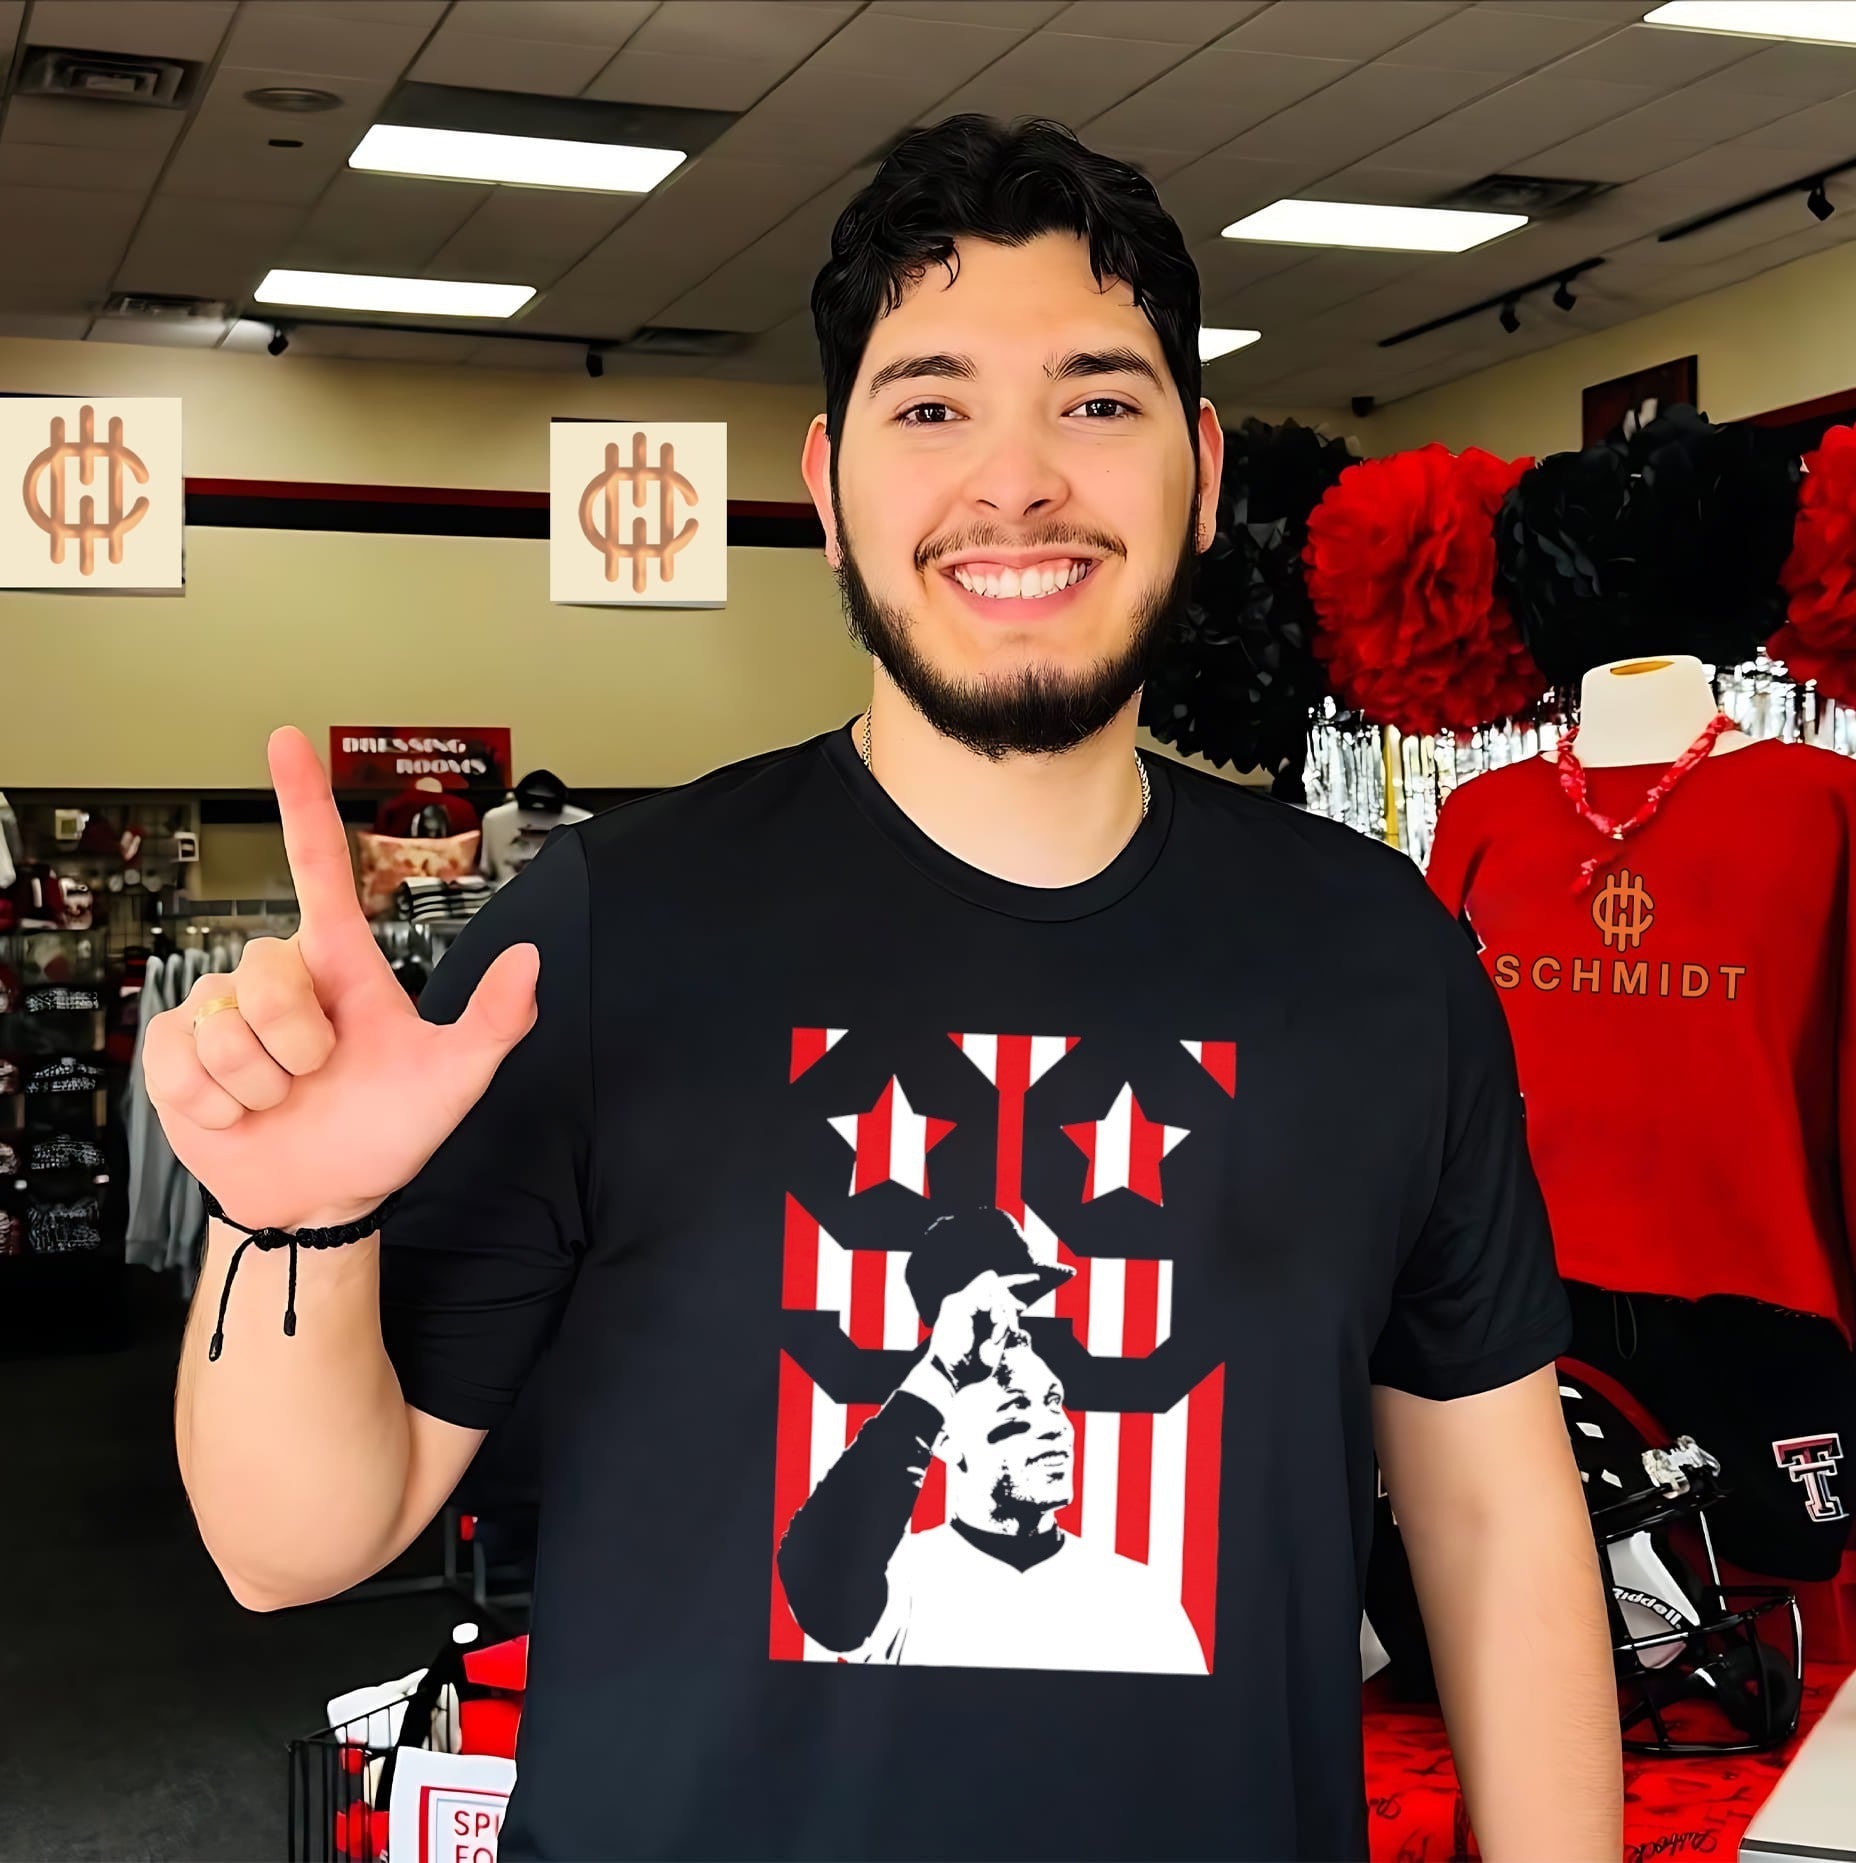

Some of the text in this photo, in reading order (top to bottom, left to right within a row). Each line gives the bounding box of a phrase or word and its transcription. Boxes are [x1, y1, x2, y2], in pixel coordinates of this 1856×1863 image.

[342, 737, 467, 754] DRESSING
[396, 758, 487, 775] ROOMS
[1494, 954, 1747, 1000] SCHMIDT
